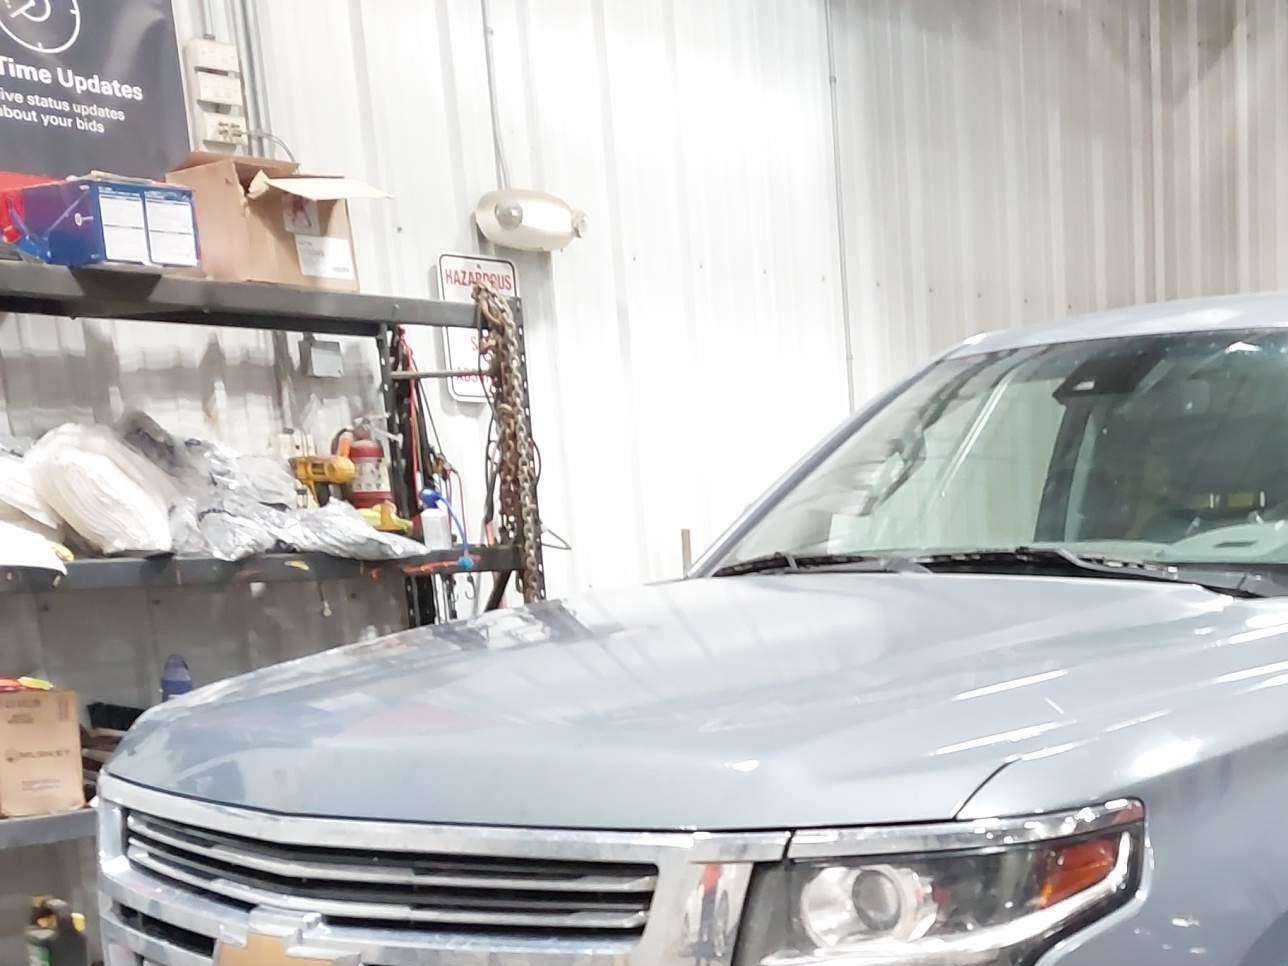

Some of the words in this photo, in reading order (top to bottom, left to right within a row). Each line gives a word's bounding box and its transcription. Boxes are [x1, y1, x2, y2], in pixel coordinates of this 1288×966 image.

[0, 55, 53, 84] Time
[56, 67, 143, 100] Updates
[26, 94, 71, 112] status
[72, 102, 126, 121] updates
[40, 113, 73, 127] your
[75, 116, 105, 133] bids
[444, 268, 512, 290] HAZARDOUS
